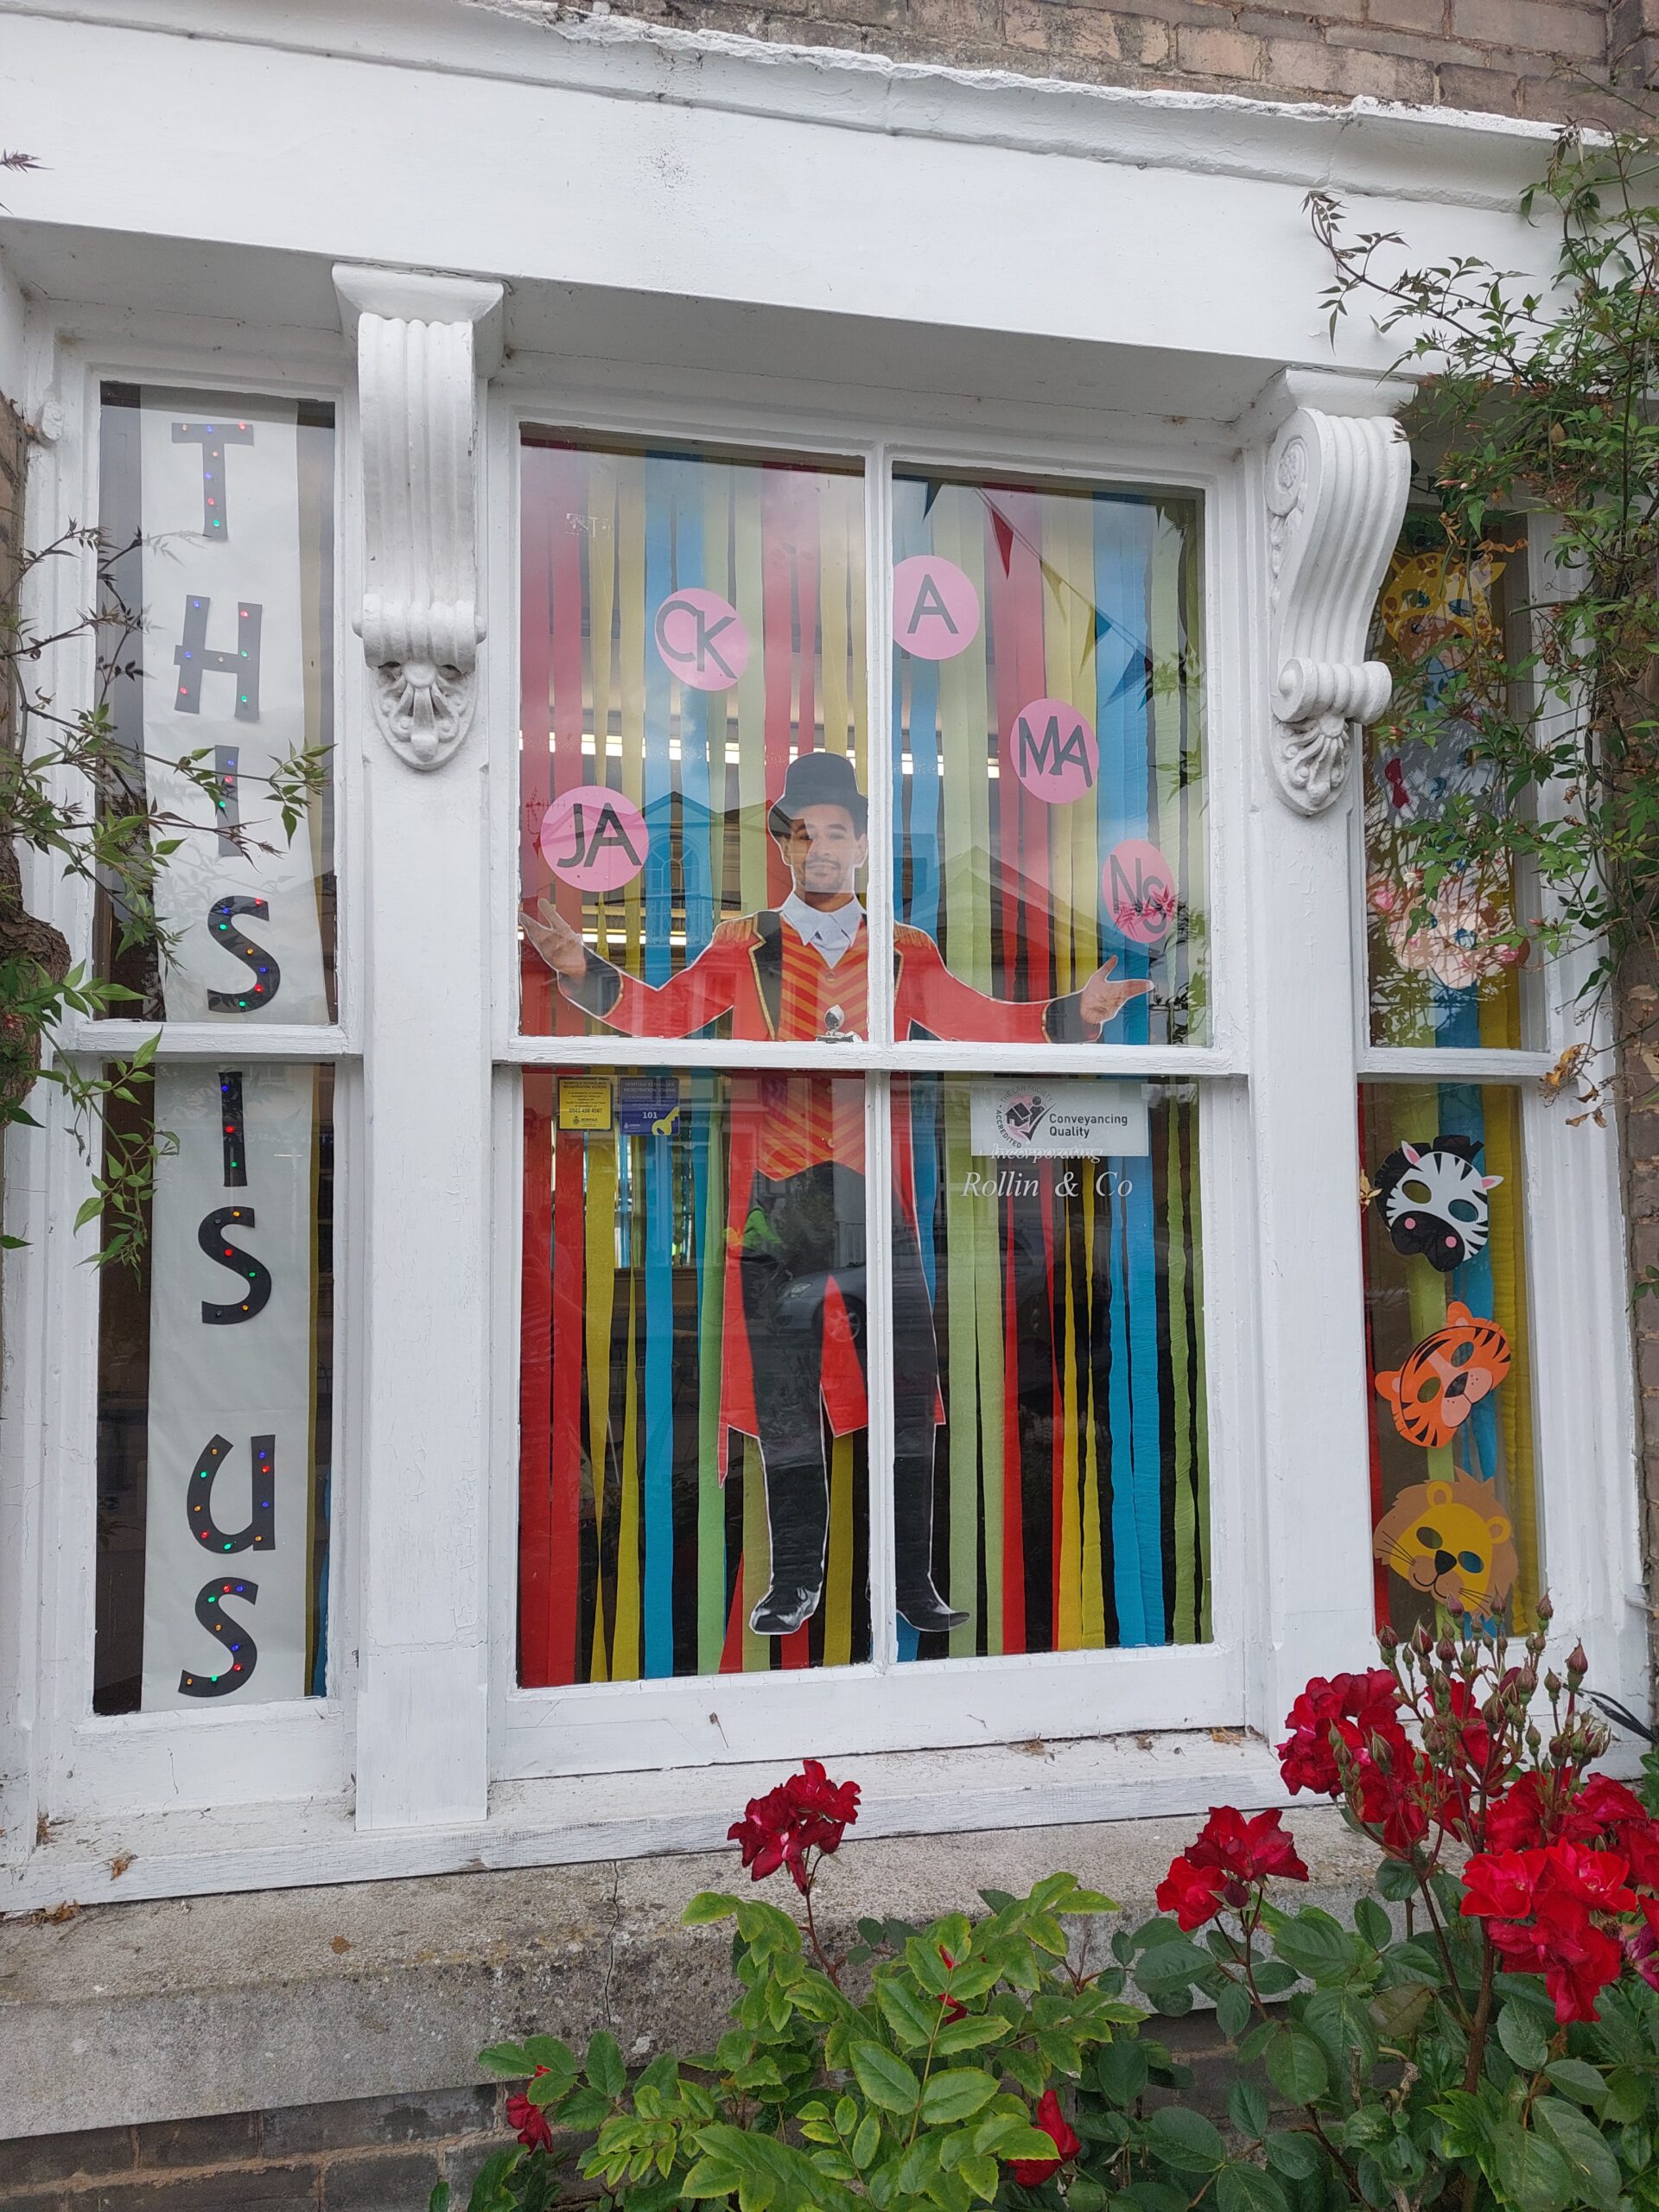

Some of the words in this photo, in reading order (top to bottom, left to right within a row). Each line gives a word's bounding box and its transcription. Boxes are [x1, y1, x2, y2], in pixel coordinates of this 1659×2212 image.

[172, 423, 281, 1014] THIS
[556, 803, 643, 869] JA
[655, 600, 736, 680] CK
[906, 574, 960, 635] A
[1018, 716, 1094, 789] MA
[1000, 1090, 1013, 1103] THE
[995, 1109, 1022, 1149] ACCREDITED
[1049, 1113, 1128, 1126] Conveyancing
[1049, 1126, 1090, 1139] Quality
[991, 1144, 1103, 1164] Incorporating
[198, 1071, 272, 1325] IS
[961, 1171, 1039, 1197] Rollin
[1054, 1171, 1079, 1198] &
[1095, 1171, 1133, 1197] Co
